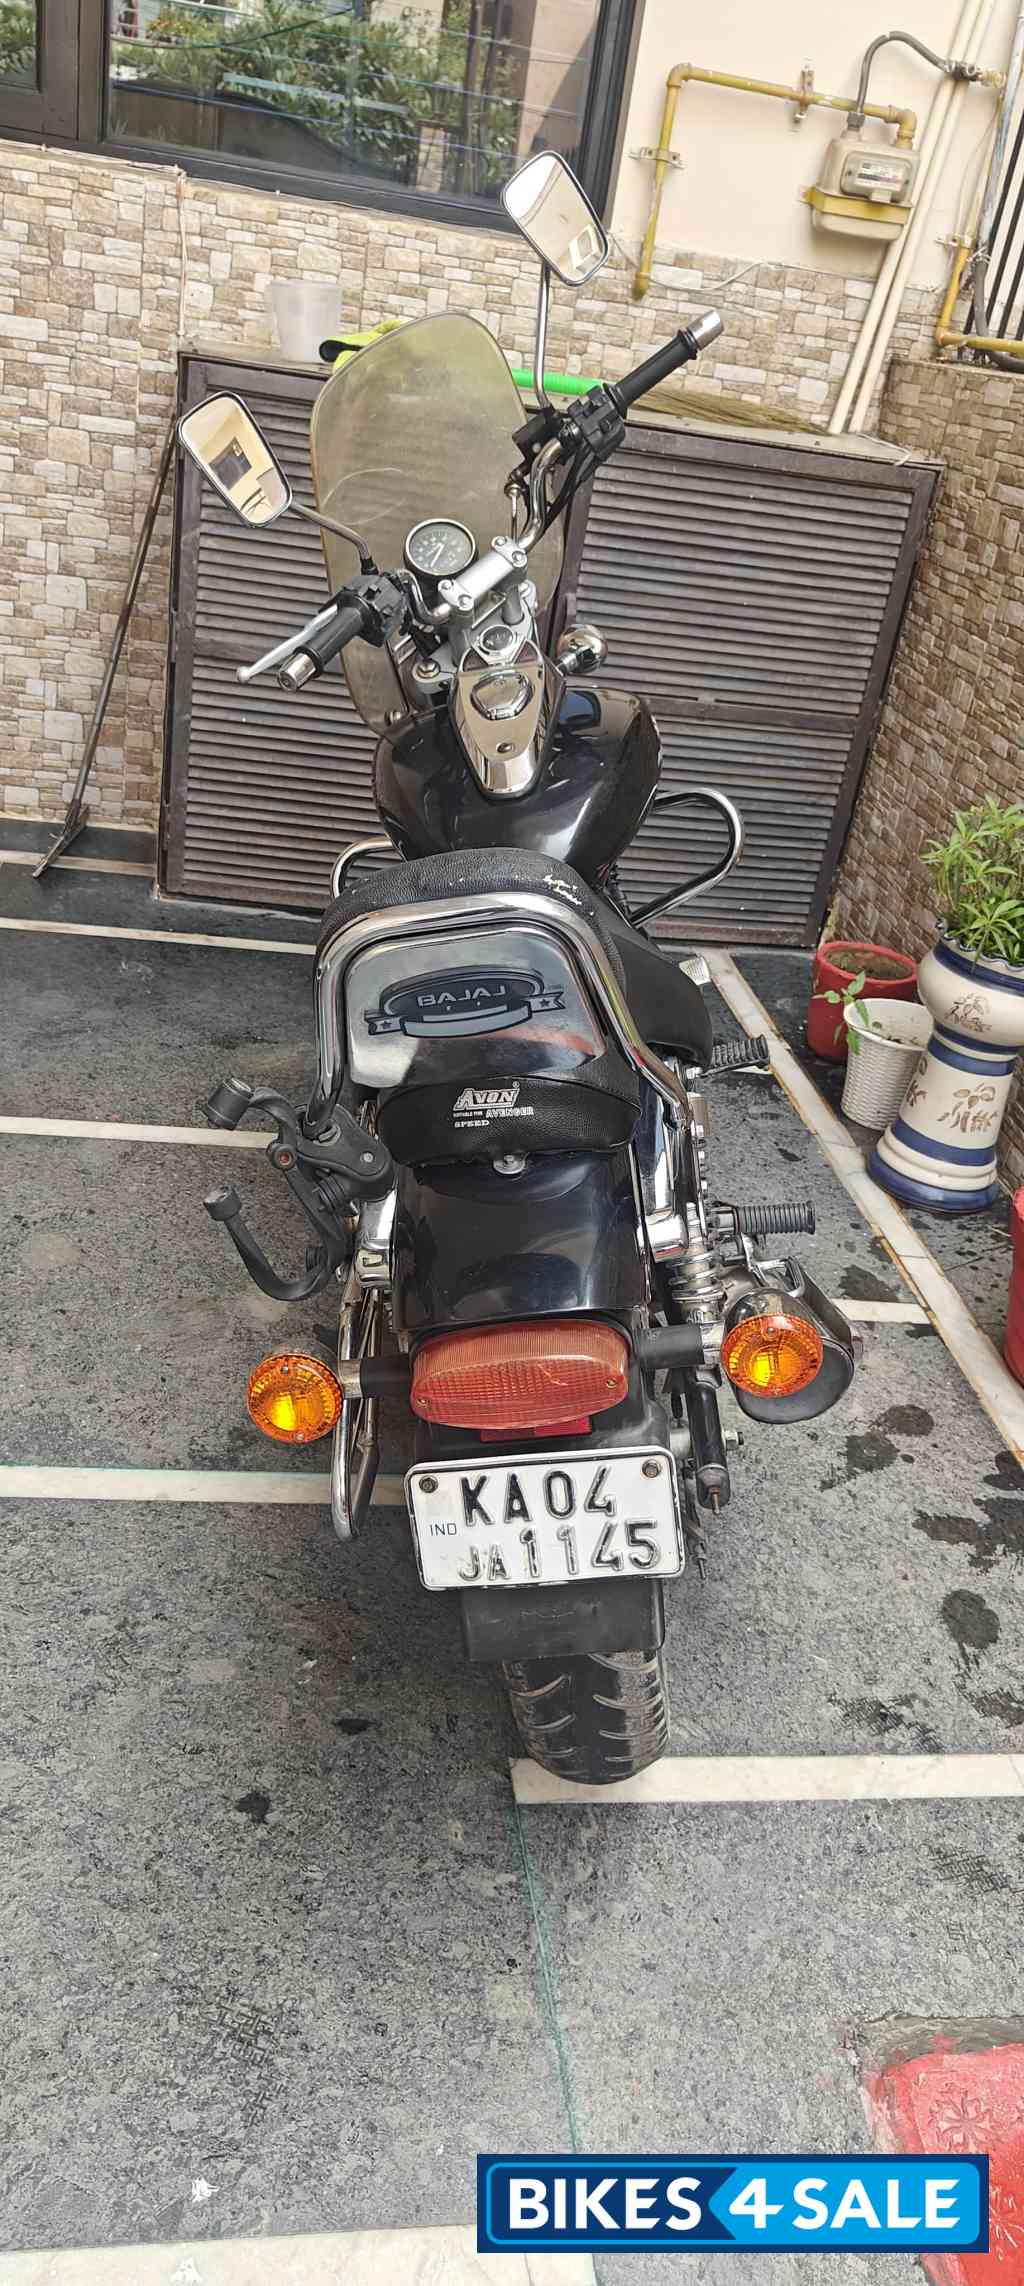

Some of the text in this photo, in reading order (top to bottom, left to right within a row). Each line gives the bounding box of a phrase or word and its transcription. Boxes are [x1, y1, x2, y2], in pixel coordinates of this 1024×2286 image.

[417, 985, 506, 1007] BAJAJ
[453, 1088, 517, 1111] AVON
[485, 1106, 534, 1118] AVENGER
[454, 1119, 490, 1128] SPEED
[460, 1465, 616, 1527] KA04
[430, 1523, 457, 1536] IND
